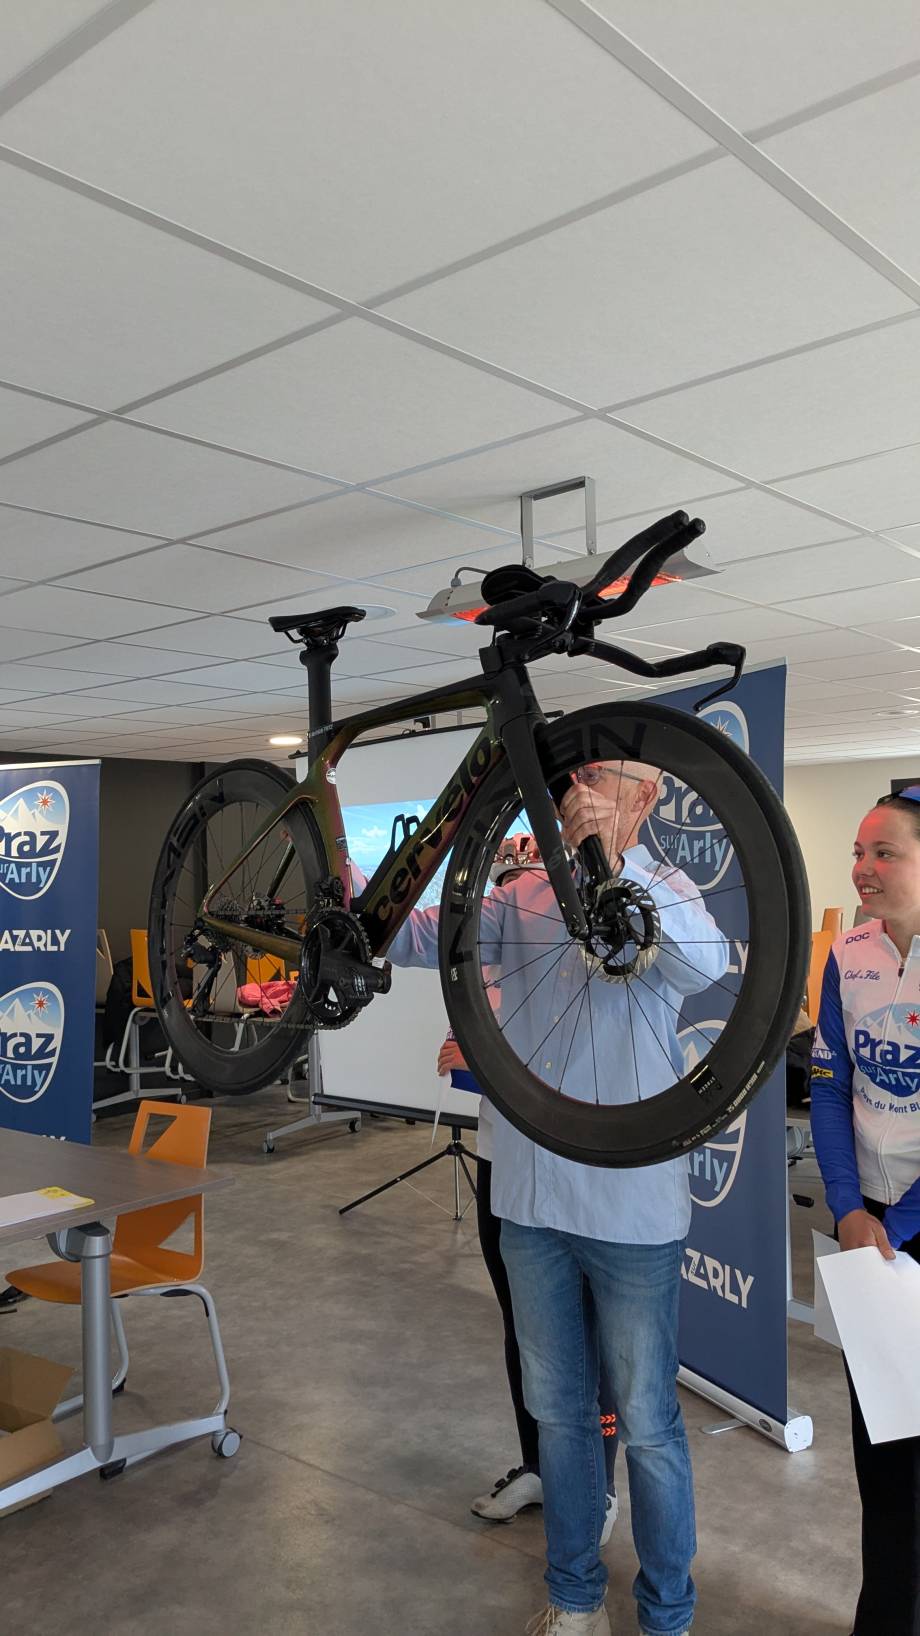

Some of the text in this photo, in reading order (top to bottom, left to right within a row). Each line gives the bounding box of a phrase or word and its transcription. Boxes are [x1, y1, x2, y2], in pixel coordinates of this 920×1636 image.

[653, 775, 718, 827] Pra
[675, 832, 727, 871] Arly
[5, 862, 50, 887] Arly
[0, 1028, 57, 1061] raz
[1, 1064, 46, 1091] Arly
[876, 1068, 918, 1091] Arly
[874, 1101, 886, 1110] du
